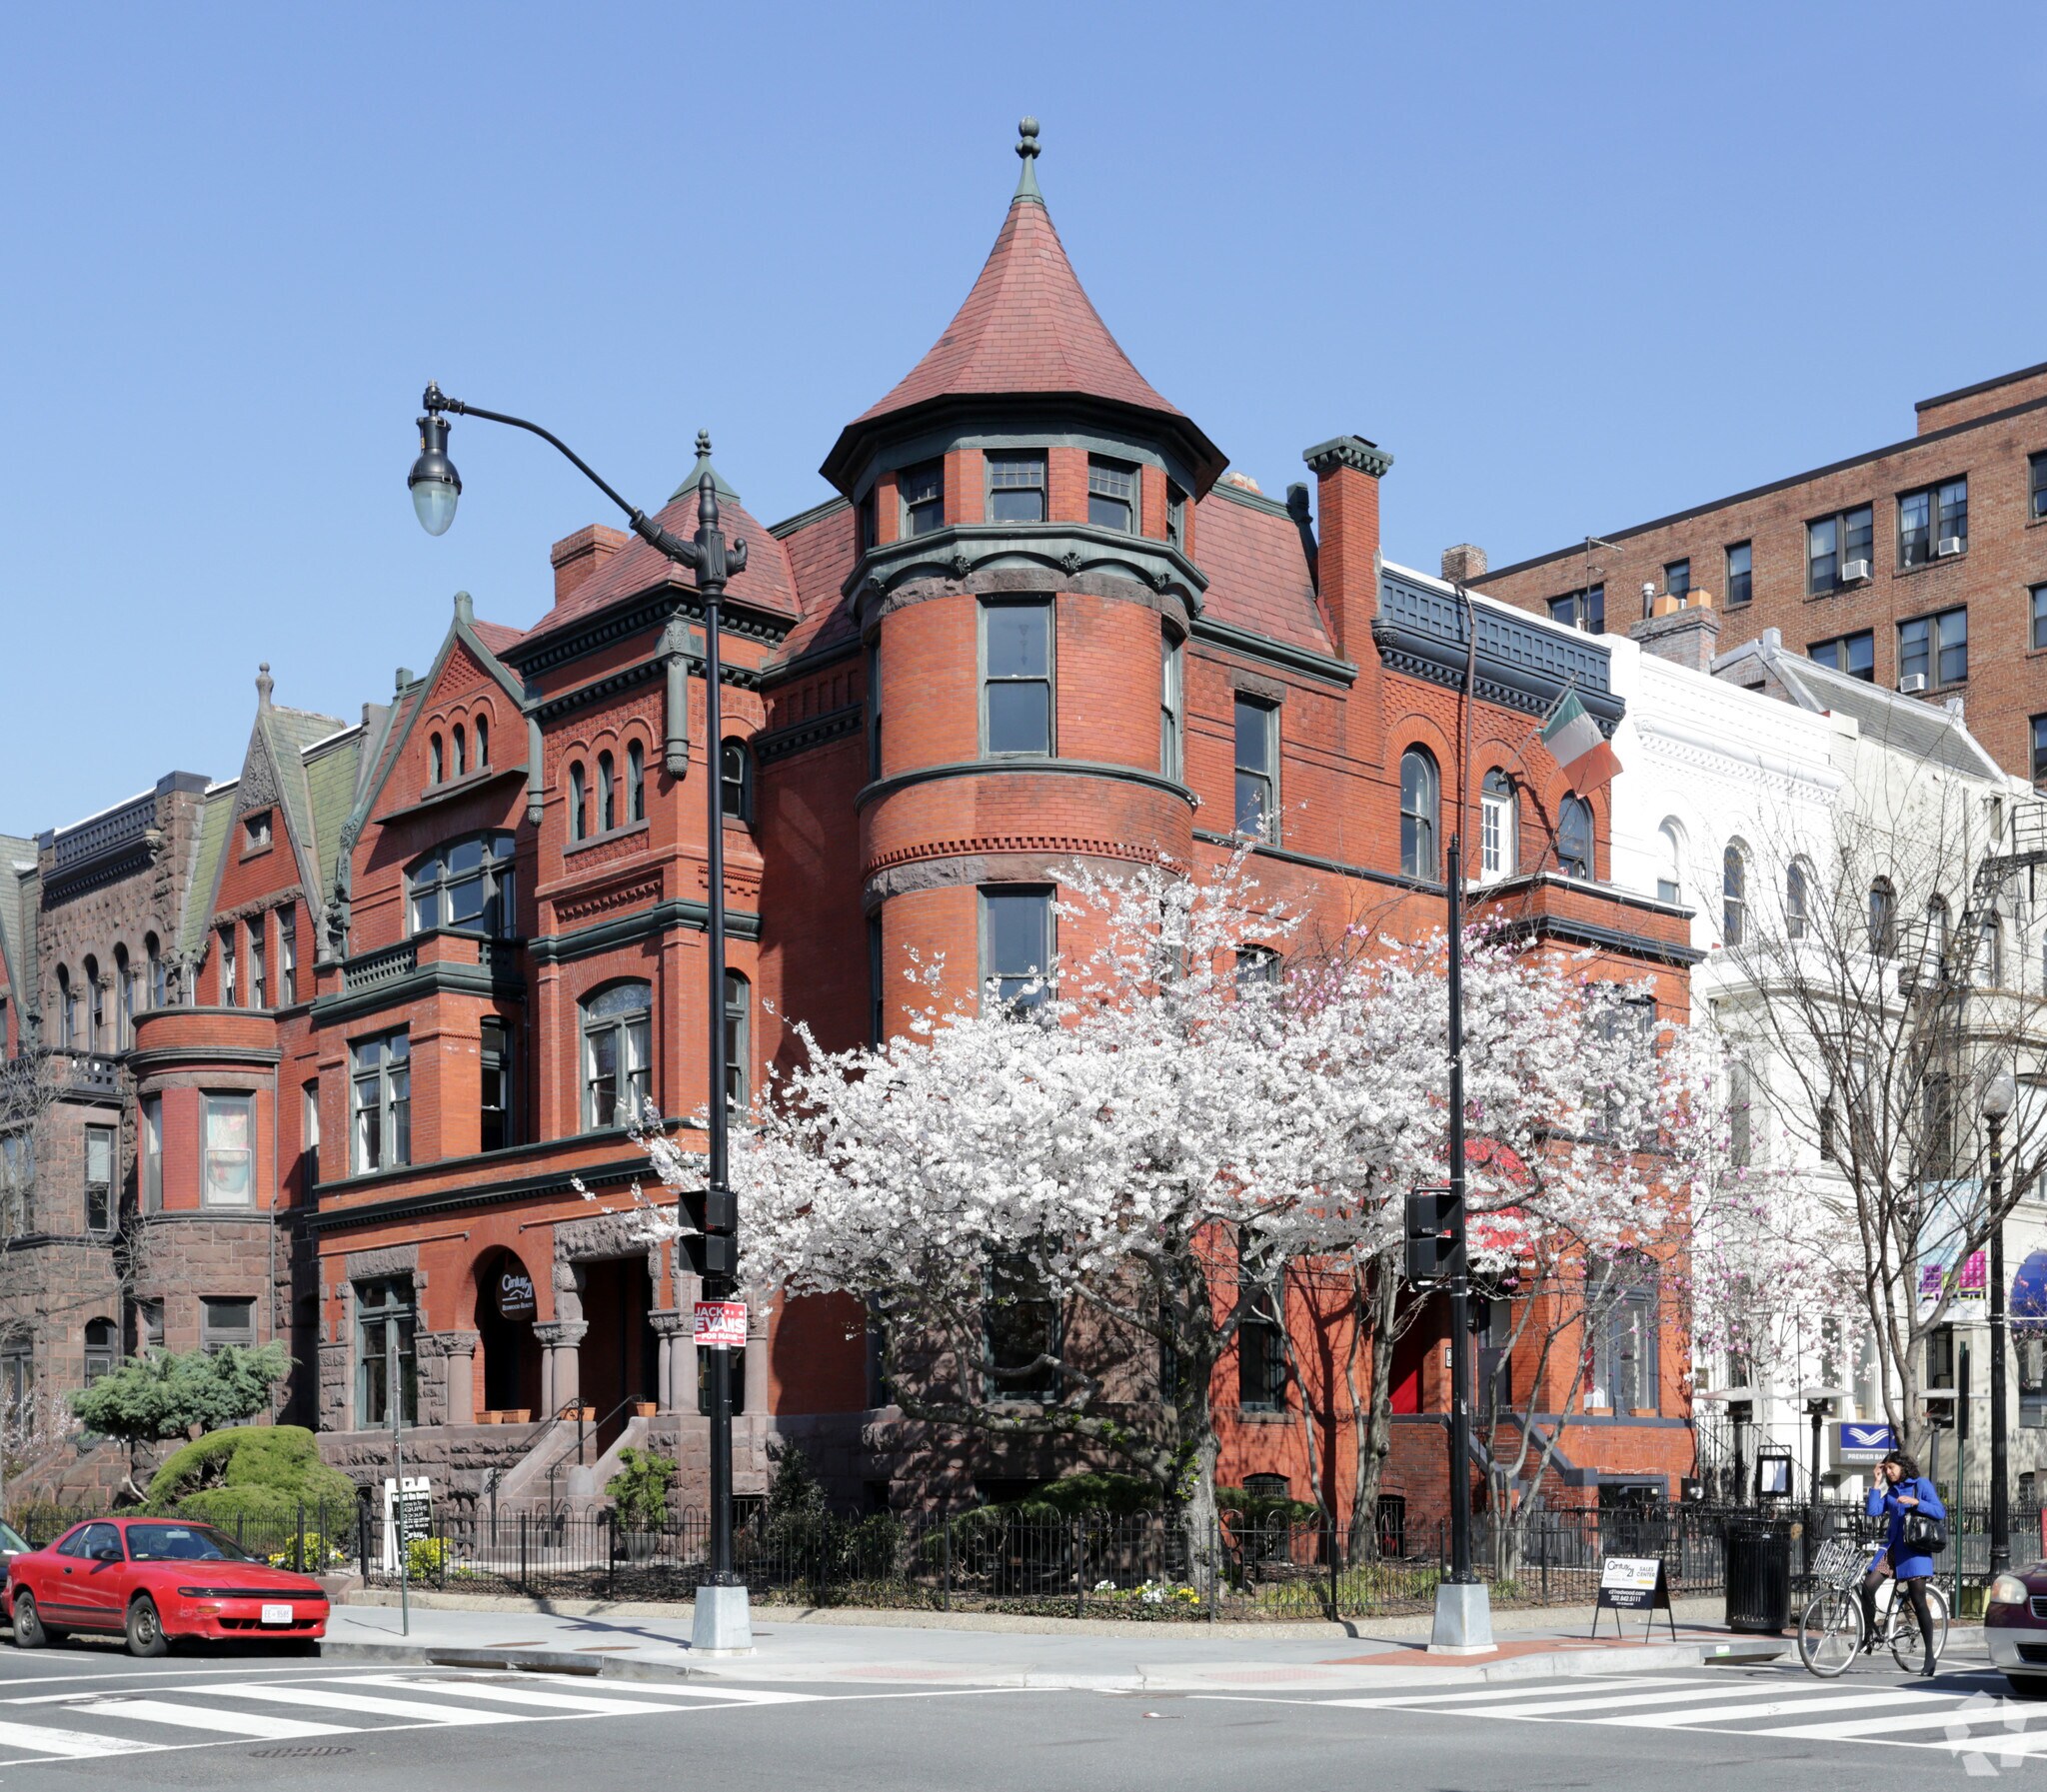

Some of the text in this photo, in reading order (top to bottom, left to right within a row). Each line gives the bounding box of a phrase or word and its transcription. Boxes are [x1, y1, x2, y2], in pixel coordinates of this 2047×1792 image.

[502, 1273, 528, 1291] Century
[695, 1306, 725, 1317] JACK
[694, 1316, 746, 1334] EVANS
[1607, 1560, 1635, 1578] Century 21
